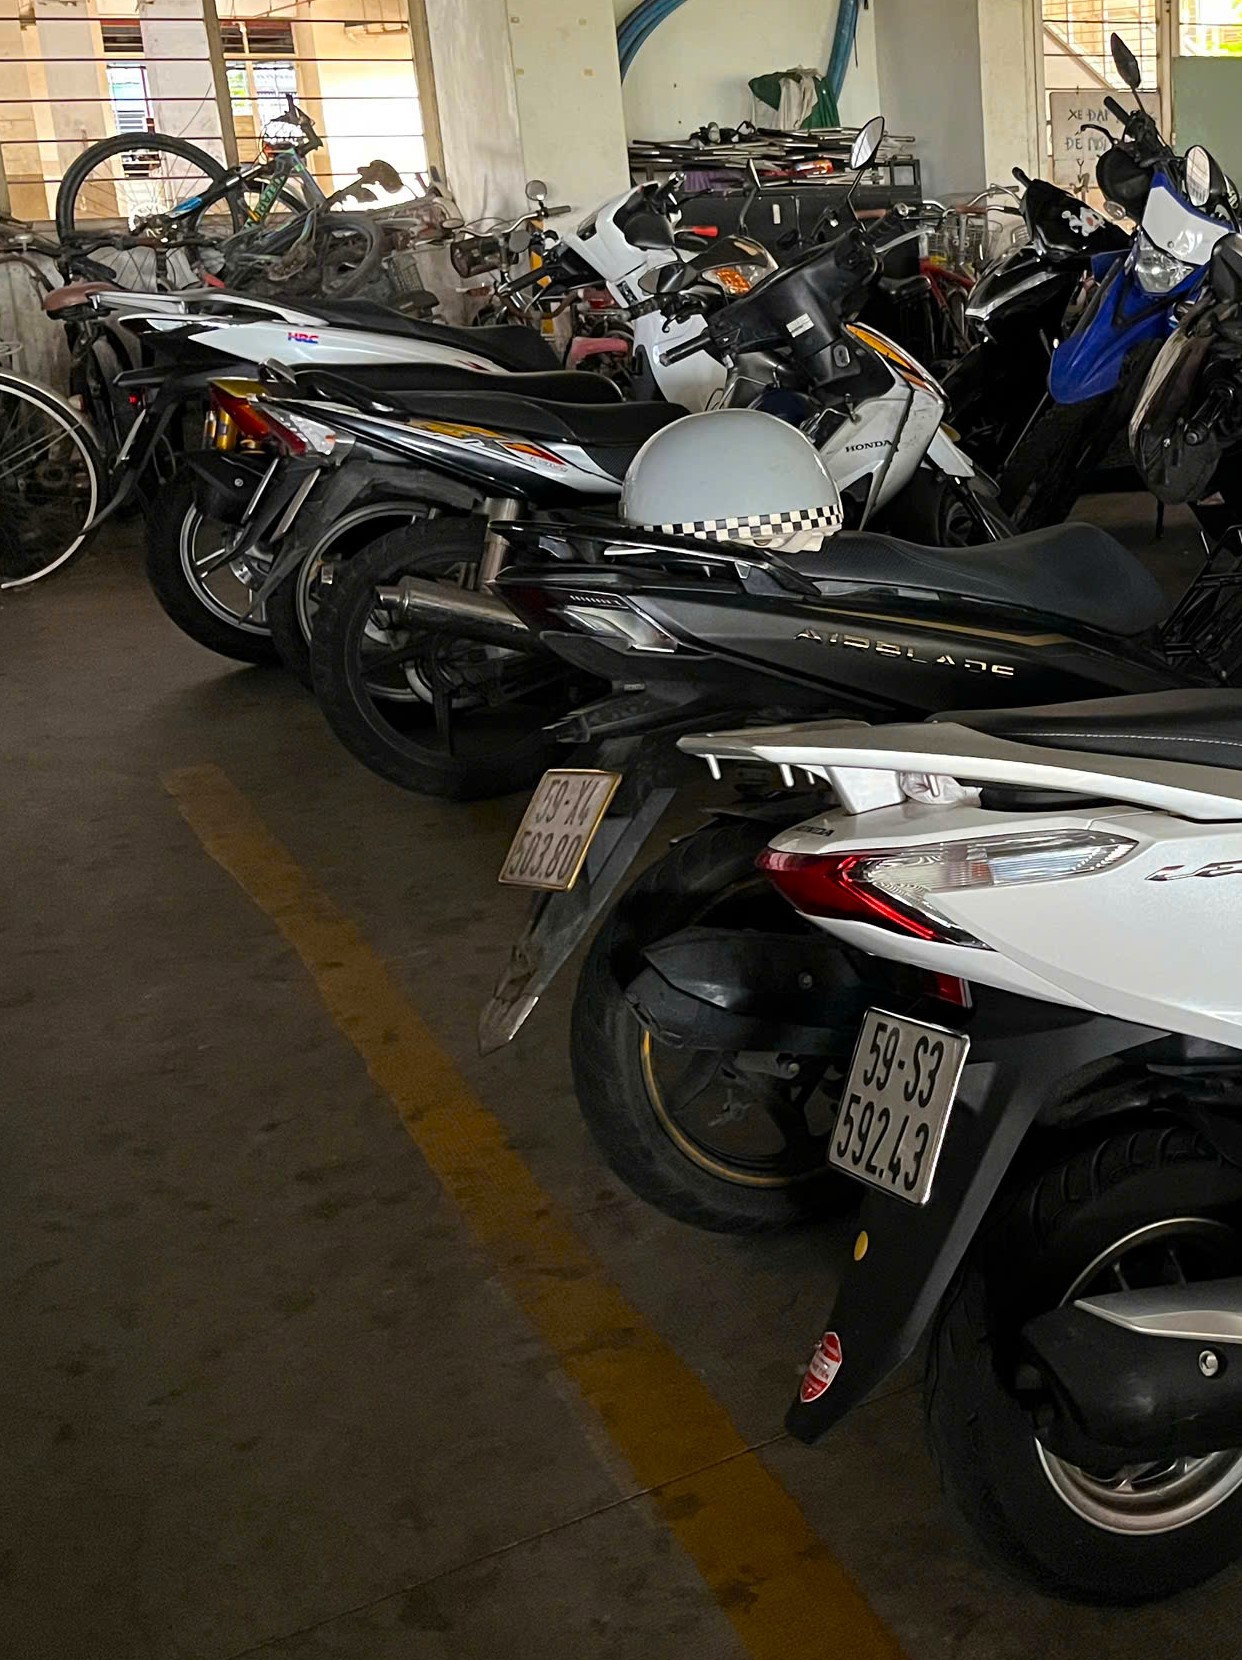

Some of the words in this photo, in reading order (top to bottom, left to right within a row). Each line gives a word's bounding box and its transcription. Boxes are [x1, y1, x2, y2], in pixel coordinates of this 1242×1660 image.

[287, 332, 319, 344] HRC
[845, 439, 899, 453] HONDA
[793, 628, 1015, 678] AIRBLADE
[508, 830, 583, 880] 503.80
[862, 1021, 945, 1109] 59-S3
[836, 1092, 930, 1192] 592.43
